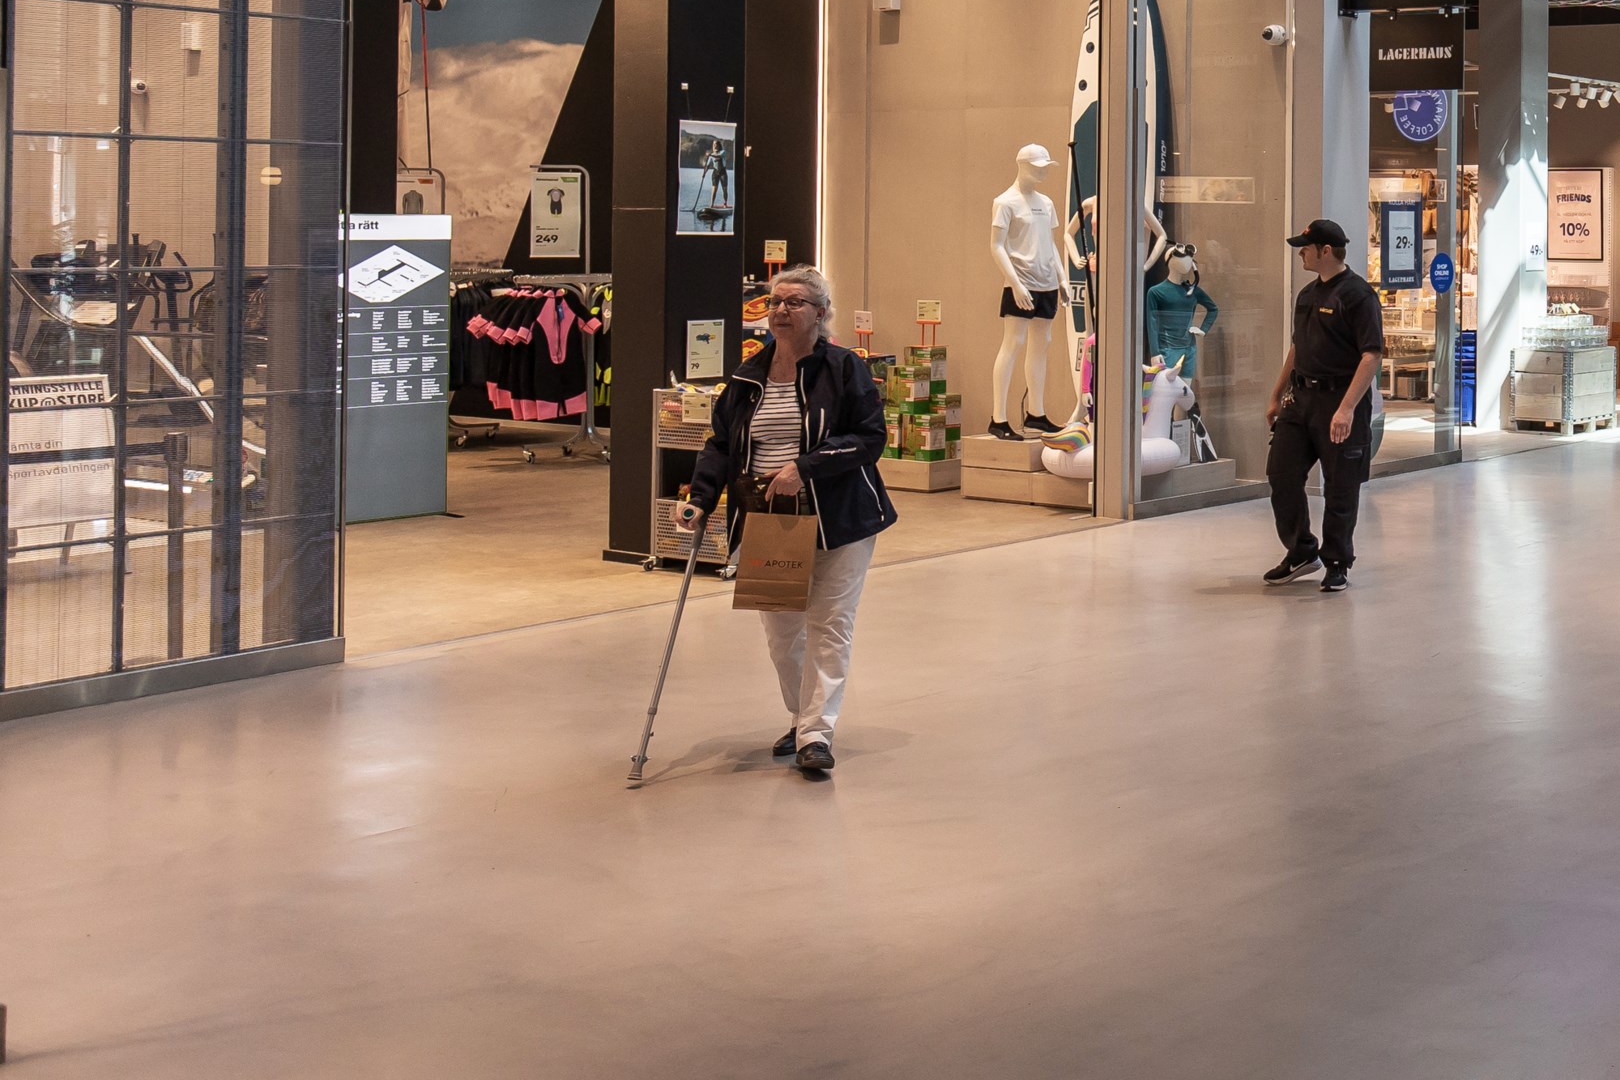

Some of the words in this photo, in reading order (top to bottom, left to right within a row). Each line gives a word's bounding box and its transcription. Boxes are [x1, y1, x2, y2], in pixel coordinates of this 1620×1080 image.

[1378, 46, 1453, 61] LAGERHAUS
[1556, 193, 1592, 204] FRIENDS
[358, 220, 379, 230] rätt
[1559, 222, 1590, 237] 10%
[535, 234, 559, 244] 249
[690, 362, 700, 370] 79
[764, 559, 804, 569] APOTEK
